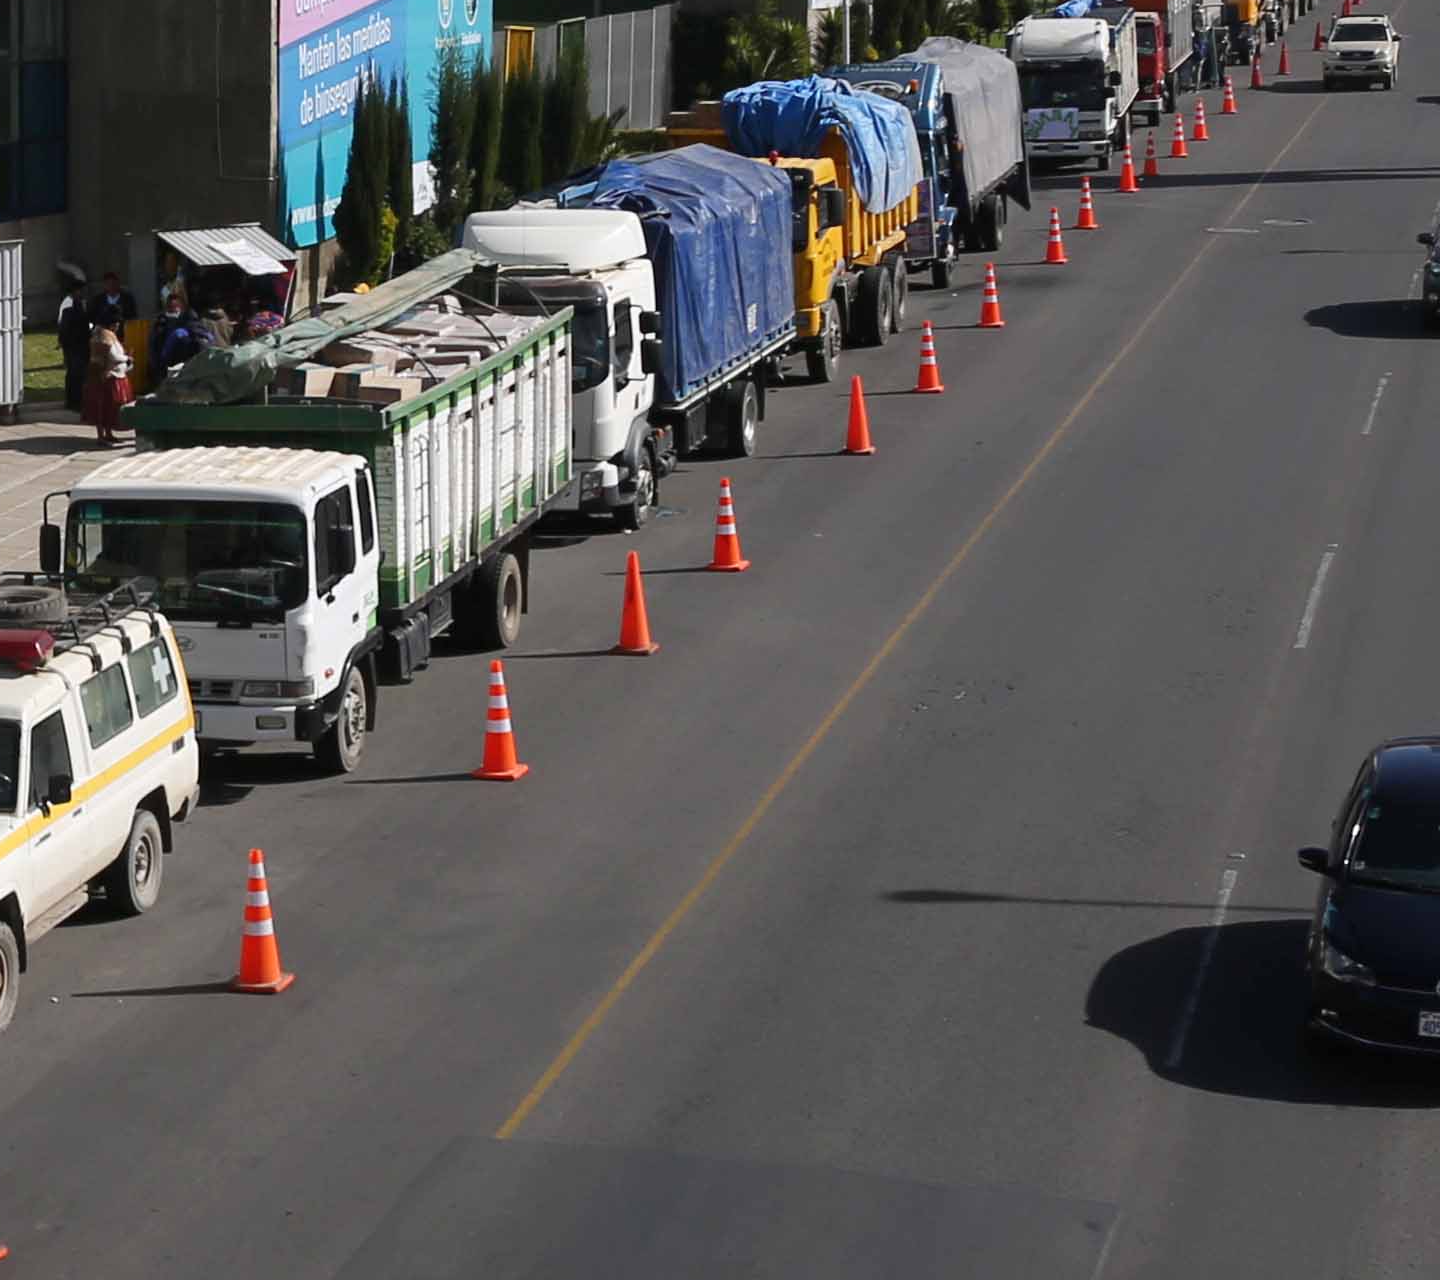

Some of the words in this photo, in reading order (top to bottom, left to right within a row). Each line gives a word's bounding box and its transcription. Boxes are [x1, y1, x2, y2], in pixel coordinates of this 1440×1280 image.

[298, 33, 335, 80] Mantén
[337, 27, 351, 62] las
[352, 12, 392, 56] medidas
[300, 90, 314, 126] de
